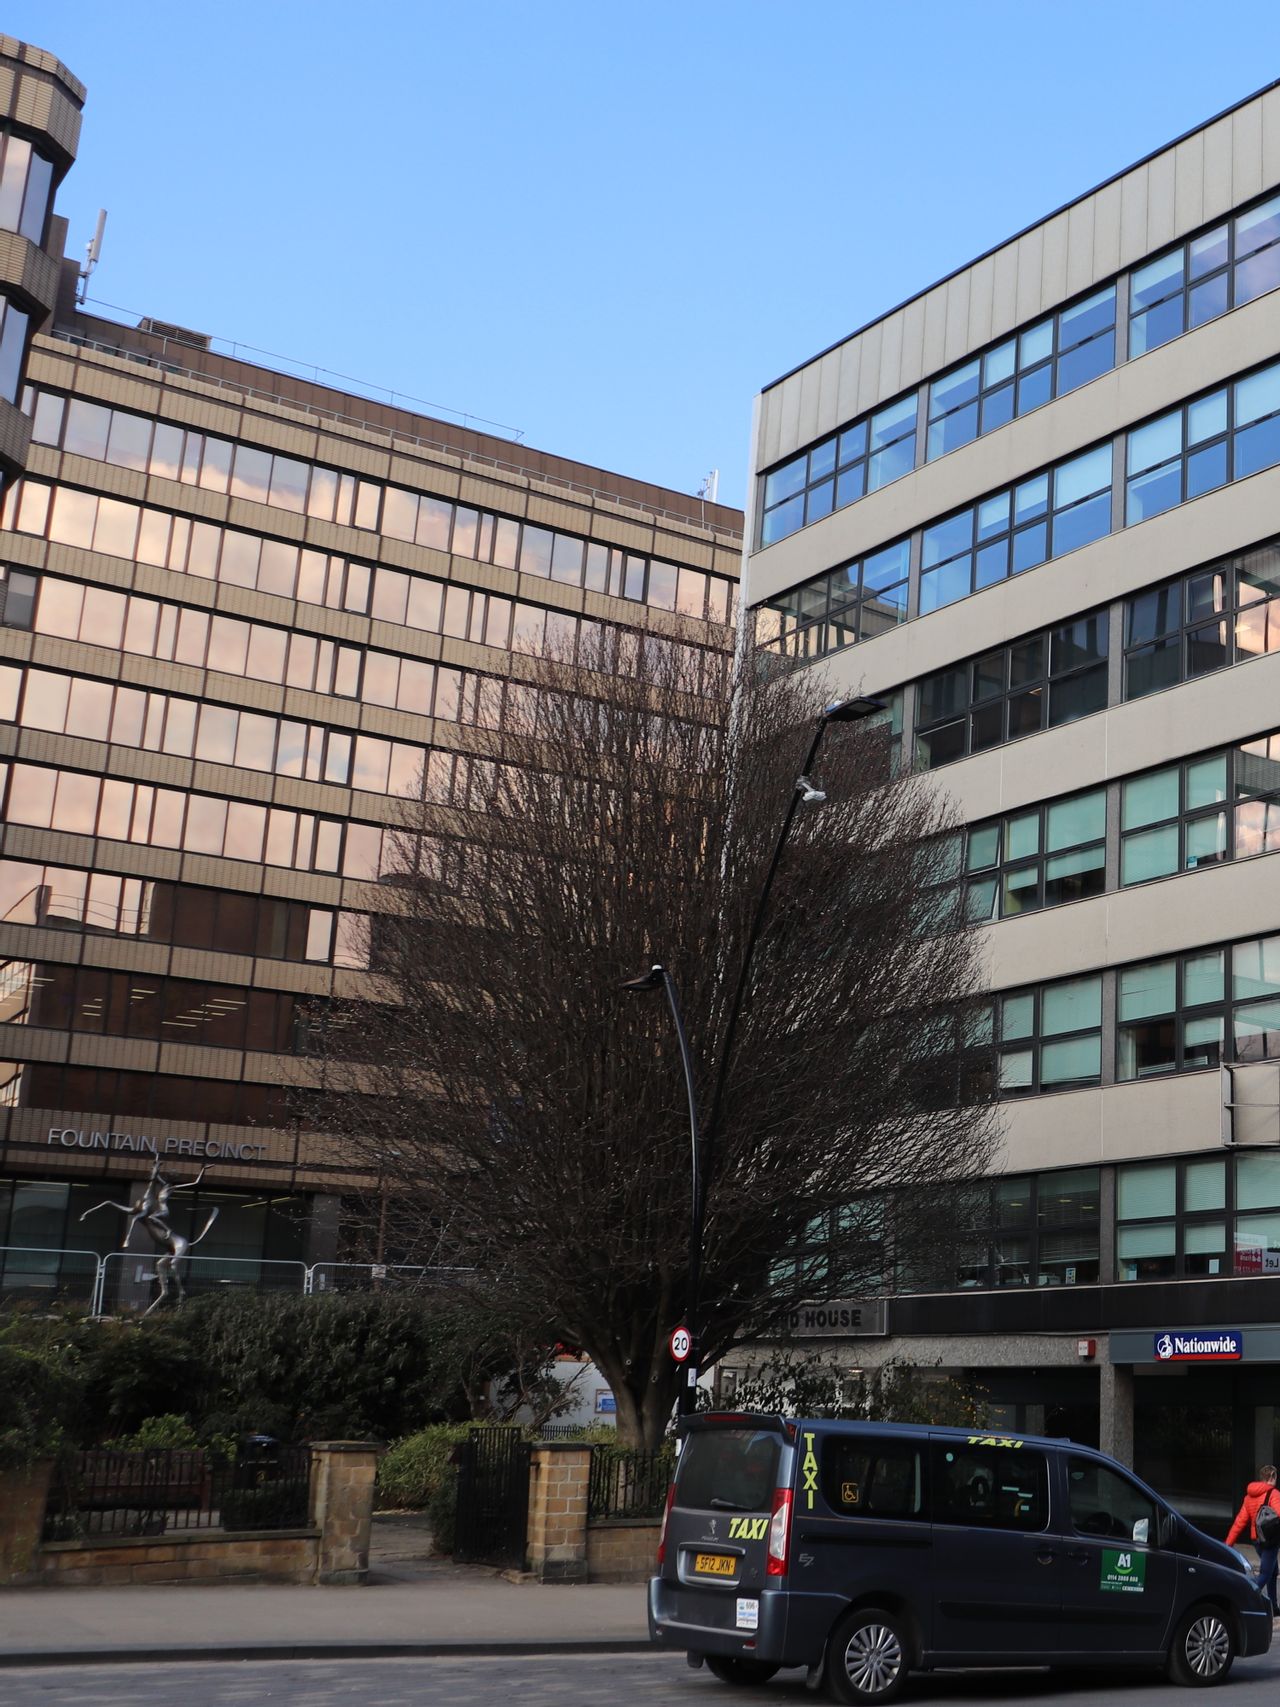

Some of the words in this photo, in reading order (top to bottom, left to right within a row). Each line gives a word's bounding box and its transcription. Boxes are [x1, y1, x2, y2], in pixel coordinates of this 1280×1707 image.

[48, 1128, 156, 1152] FOUNTAIN
[164, 1137, 268, 1161] PRECINCT
[804, 1309, 862, 1327] HOUSE
[674, 1336, 688, 1351] 20
[1174, 1336, 1237, 1354] Nationwide
[966, 1435, 1024, 1449] TAXI
[802, 1432, 819, 1509] TAXI
[728, 1518, 770, 1540] TAXI
[700, 1558, 716, 1571] SF12
[1117, 1553, 1131, 1568] A1
